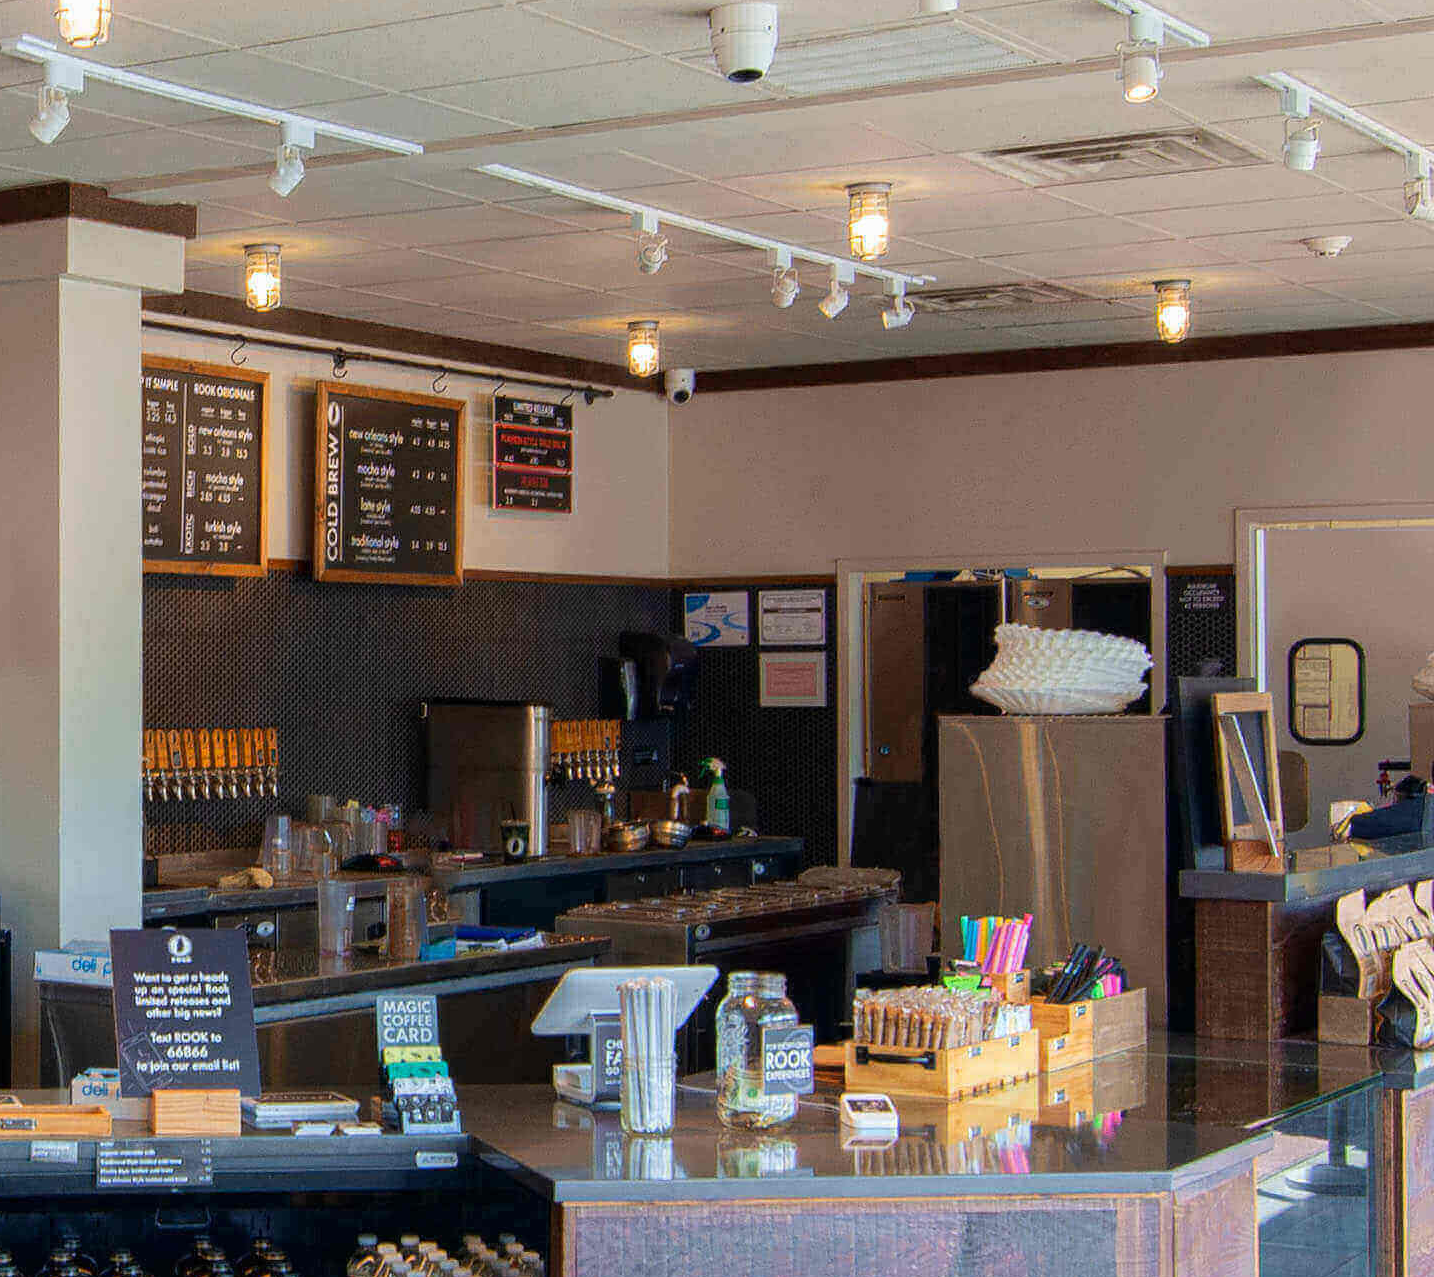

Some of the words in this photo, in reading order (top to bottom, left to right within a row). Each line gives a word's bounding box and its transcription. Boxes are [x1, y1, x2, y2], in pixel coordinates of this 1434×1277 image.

[328, 433, 339, 495] BREW
[327, 502, 339, 562] COLD
[71, 956, 97, 973] deli
[133, 972, 161, 983] Want
[161, 974, 172, 983] to
[173, 973, 189, 984] get
[199, 971, 229, 982] heads
[134, 986, 148, 996] up
[168, 984, 202, 996] special
[205, 984, 230, 994] Rook
[135, 995, 168, 1006] limited
[170, 995, 210, 1006] releases
[211, 995, 231, 1006] and
[146, 1008, 172, 1018] other
[174, 1007, 191, 1020] big
[383, 1001, 431, 1014] MAGIC
[382, 1014, 432, 1027] COFFEE
[150, 1032, 172, 1043] Text
[174, 1032, 209, 1043] ROOK
[211, 1032, 222, 1043] to
[383, 1027, 433, 1044] CARD
[765, 1049, 811, 1070] ROOK
[136, 1061, 148, 1071] to
[150, 1061, 170, 1074] join
[172, 1062, 188, 1071] our
[192, 1059, 220, 1071] email
[81, 1083, 108, 1096] deli
